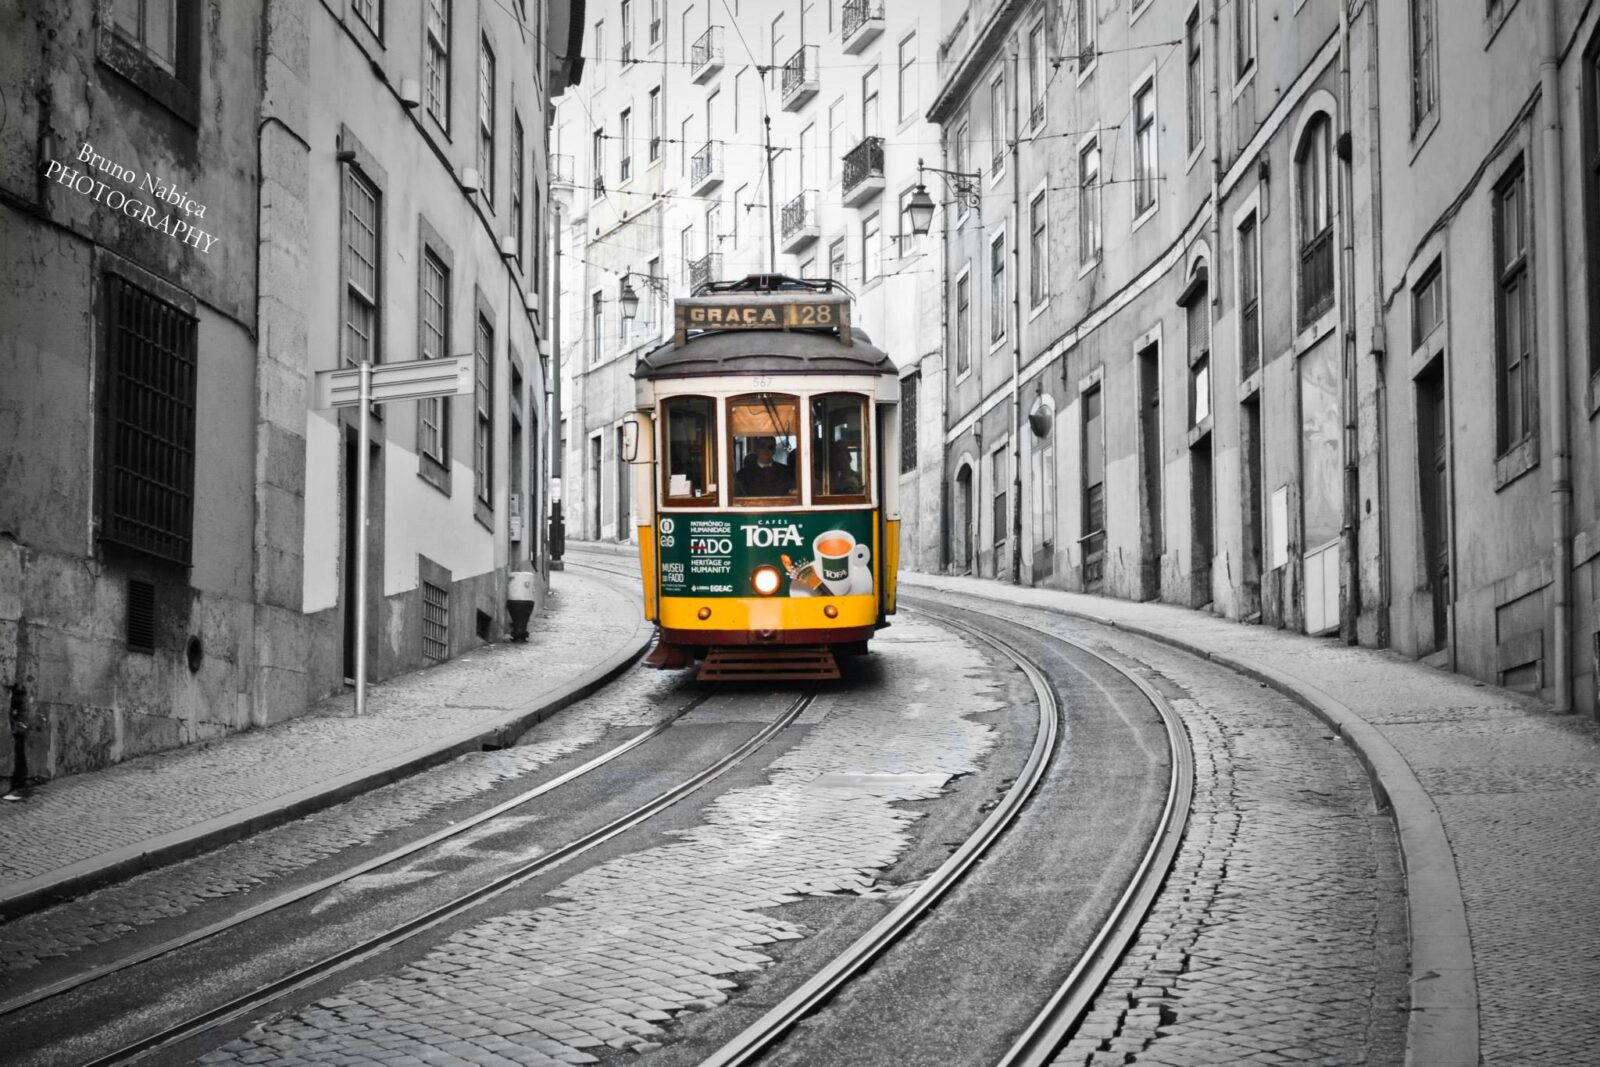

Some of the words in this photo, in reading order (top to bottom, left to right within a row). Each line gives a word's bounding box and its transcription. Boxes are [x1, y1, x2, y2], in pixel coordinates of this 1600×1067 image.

[690, 308, 776, 324] GRAÇA
[801, 305, 832, 324] 28
[752, 376, 773, 388] 567
[740, 524, 804, 547] TOFA
[690, 539, 732, 554] FADO
[662, 563, 684, 572] MUSEU
[668, 573, 685, 583] FADO
[823, 569, 848, 579] TOFA
[710, 584, 733, 592] EGEAC
